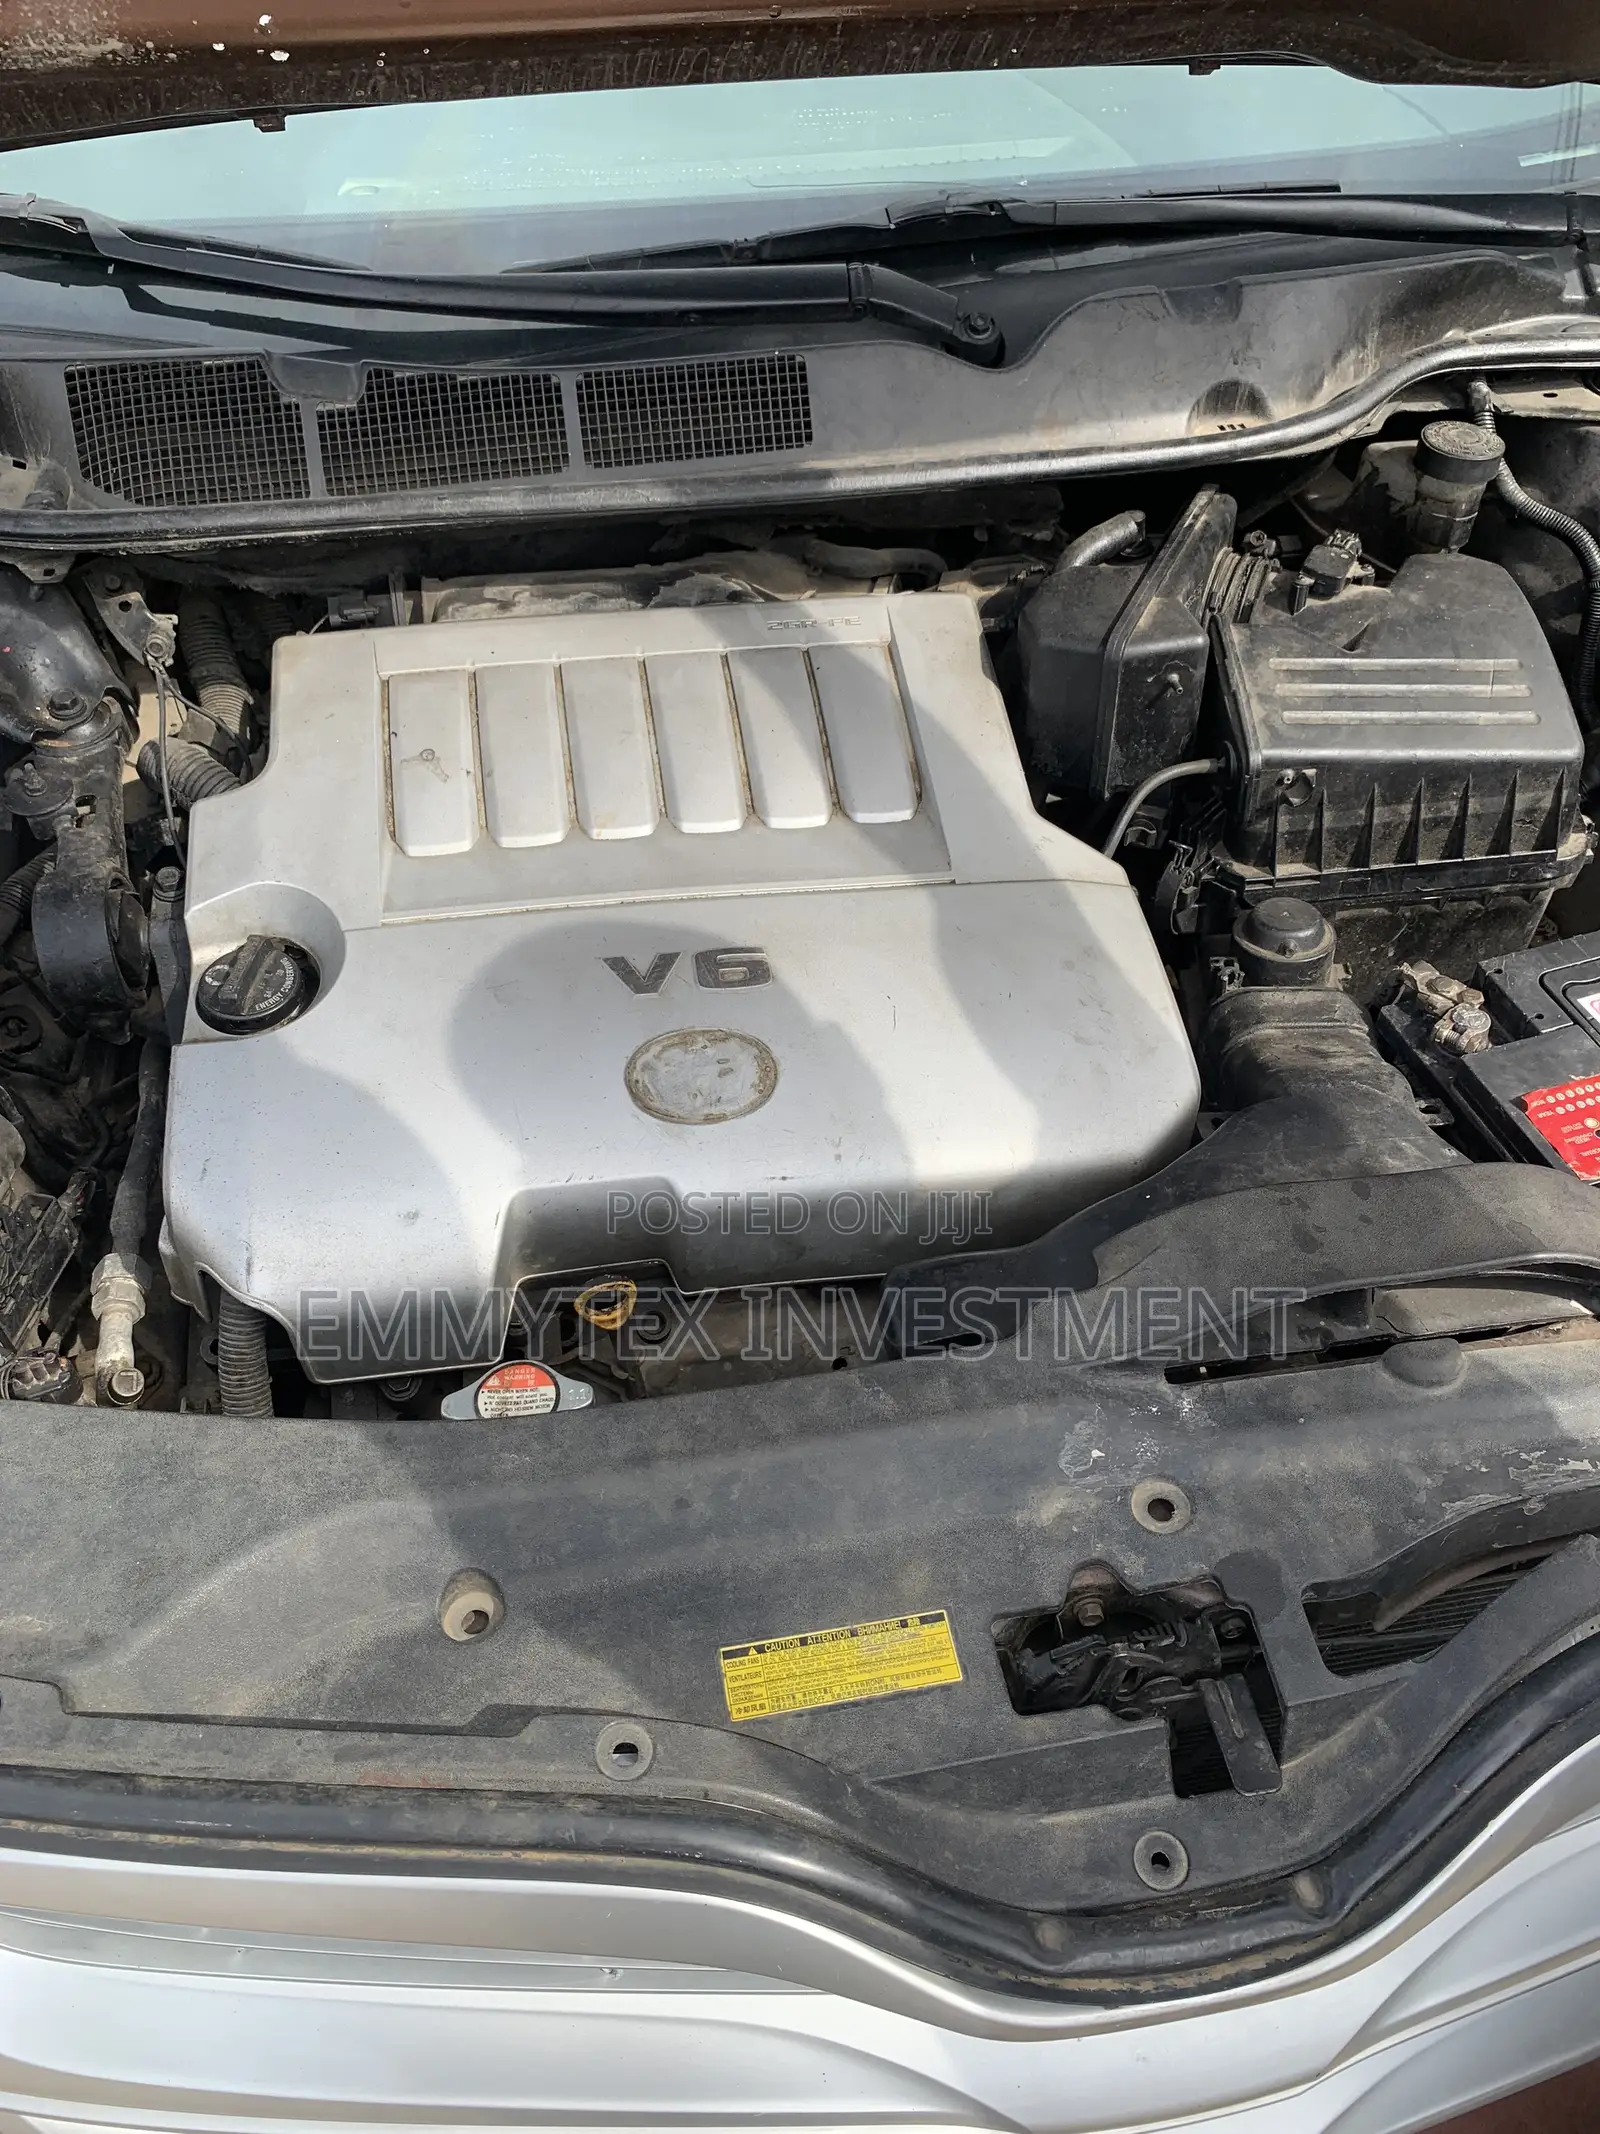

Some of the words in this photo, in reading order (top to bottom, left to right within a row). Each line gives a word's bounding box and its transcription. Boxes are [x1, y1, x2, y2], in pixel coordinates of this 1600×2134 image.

[767, 616, 861, 630] 2GR-FE
[601, 947, 773, 997] V6
[255, 993, 283, 1011] ENERGY
[280, 957, 295, 993] CONSERVING
[1537, 1110, 1555, 1118] YEAR
[857, 1621, 901, 1636] ВНИМАНИЕ!
[764, 1639, 800, 1652] CAUTION
[807, 1630, 851, 1645] ATTENTION
[726, 1659, 746, 1669] COOLING
[747, 1657, 760, 1665] FANS
[729, 1672, 762, 1683] VENTILATEURS
